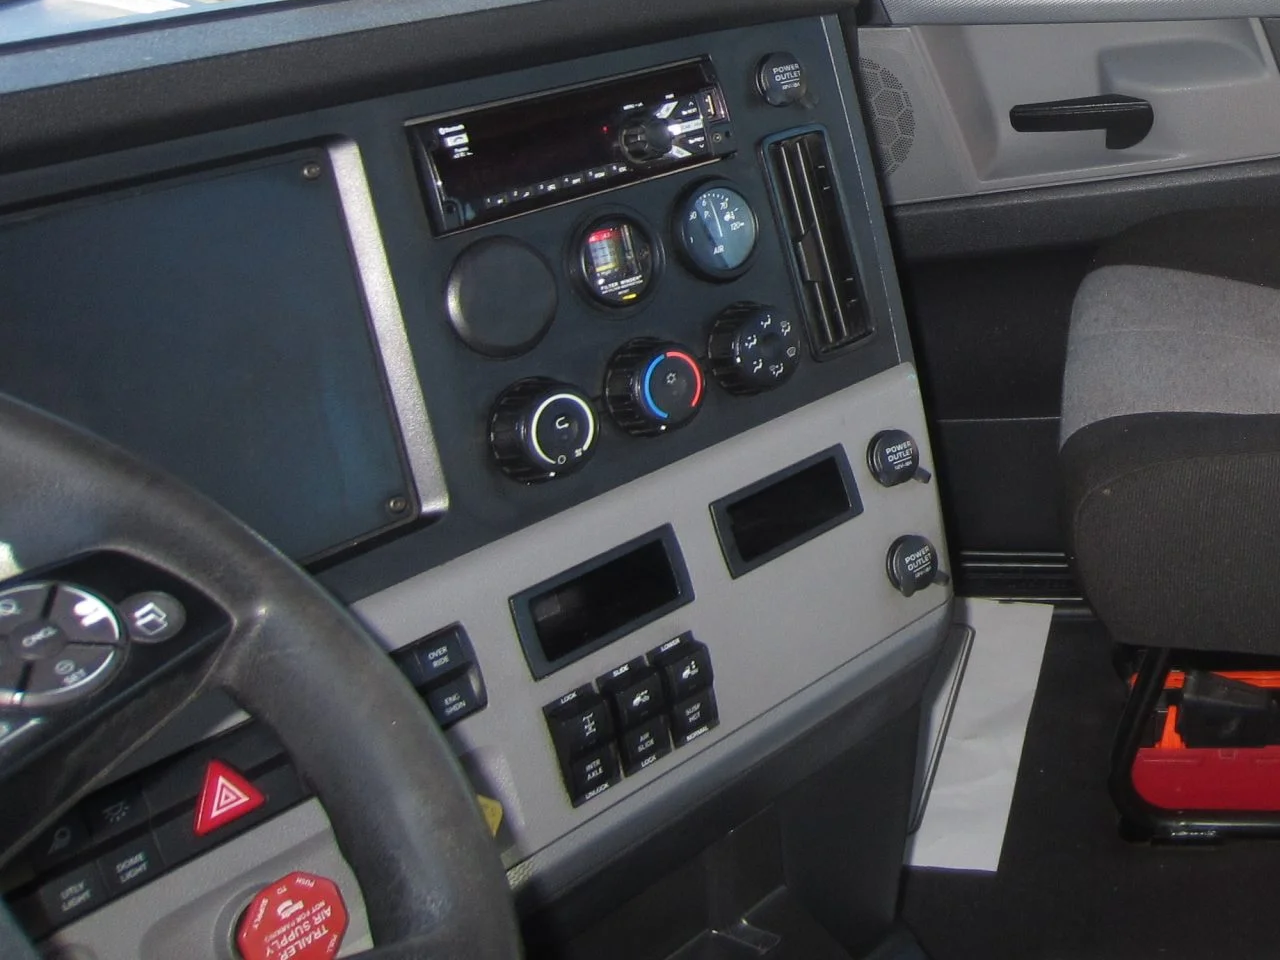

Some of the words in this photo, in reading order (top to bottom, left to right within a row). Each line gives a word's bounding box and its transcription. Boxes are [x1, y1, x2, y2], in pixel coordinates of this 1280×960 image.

[772, 63, 799, 74] POWER
[775, 70, 800, 81] OUTLET
[714, 245, 724, 255] AIR
[885, 441, 911, 455] POWER
[888, 448, 913, 462] OUTLET
[905, 545, 930, 564] POWER
[908, 552, 931, 571] OUTLET
[661, 638, 680, 652] LOWER
[428, 646, 448, 660] OVER
[432, 655, 449, 668] RIDE
[63, 668, 87, 685] SET
[613, 664, 630, 678] SLIDE
[560, 692, 577, 705] LOCK
[640, 732, 650, 742] AIR
[686, 726, 709, 741] NORMAL
[638, 739, 655, 753] SLIDE
[641, 755, 656, 768] LOCK
[586, 768, 603, 781] AXLE
[585, 783, 609, 800] UNLOCK
[116, 851, 145, 873] DOME
[120, 862, 147, 884] LIGHT
[296, 877, 315, 888] PUSH
[276, 885, 288, 895] TO
[311, 900, 326, 914] NOT
[296, 910, 310, 923] FOR
[312, 905, 332, 926] AIR
[266, 920, 311, 957] SUPPLY
[279, 924, 329, 960] TRAILER
